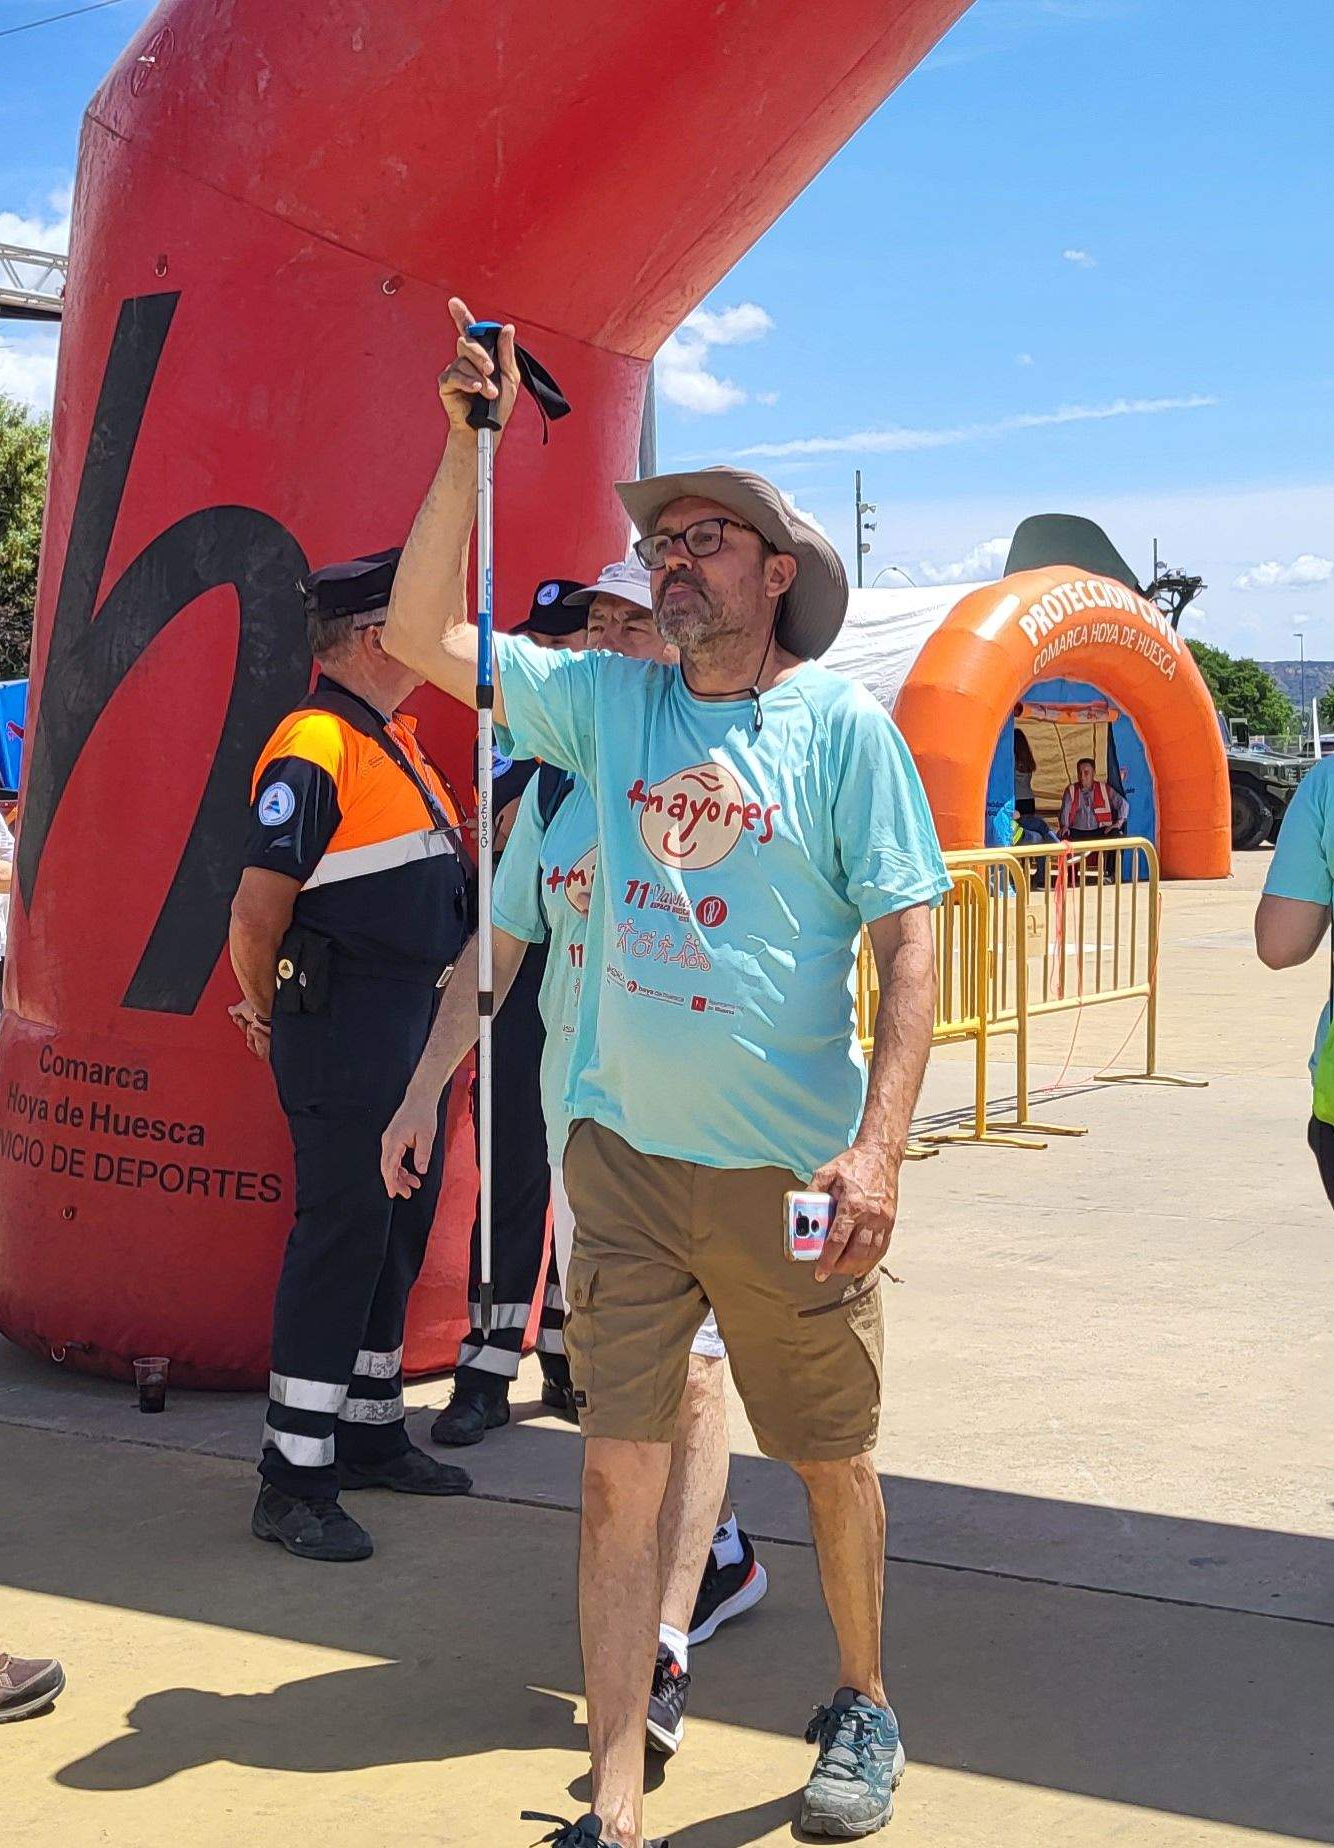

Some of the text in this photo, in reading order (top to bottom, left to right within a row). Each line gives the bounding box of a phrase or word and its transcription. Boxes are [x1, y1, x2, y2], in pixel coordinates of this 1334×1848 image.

[1033, 623, 1176, 681] COMARCA HOYA DE HUESCA
[1139, 599, 1181, 655] CIVIL
[627, 779, 781, 844] +mayores
[39, 1044, 149, 1091] Comarca
[7, 1081, 205, 1147] Hoya de Huesca
[50, 1143, 86, 1178] DE
[93, 1152, 283, 1203] DEPORTES
